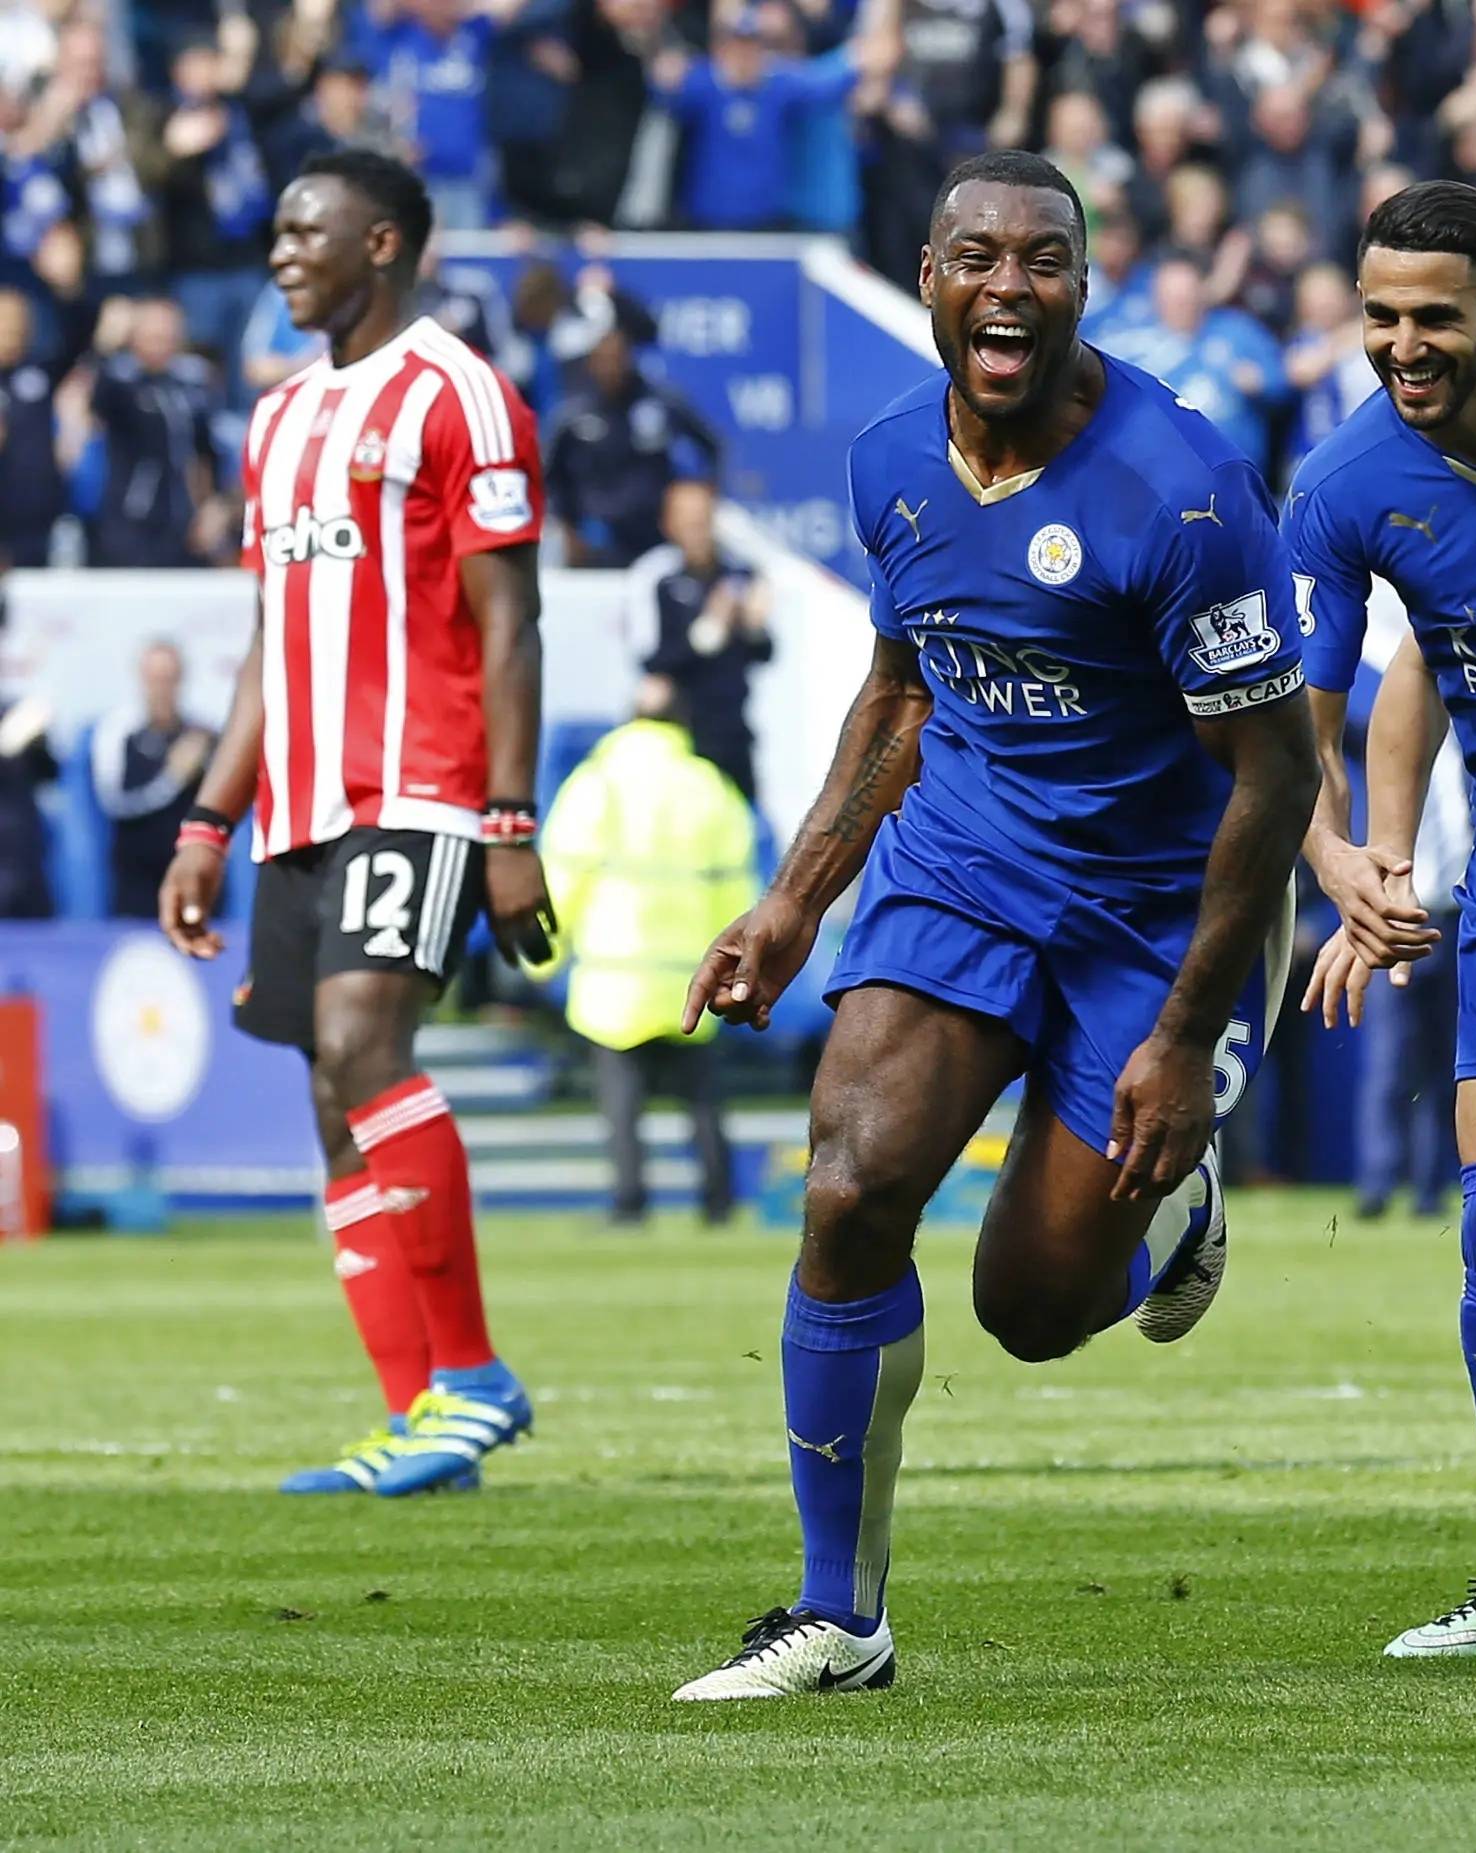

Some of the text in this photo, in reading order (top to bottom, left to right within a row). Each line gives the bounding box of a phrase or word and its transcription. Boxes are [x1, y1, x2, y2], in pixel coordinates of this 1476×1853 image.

[262, 505, 363, 564] eho
[1208, 637, 1257, 660] BARCLAYS
[930, 659, 1088, 718] OWER
[1246, 666, 1304, 703] CAPT
[340, 849, 415, 933] 12
[1212, 1018, 1251, 1118] 5
